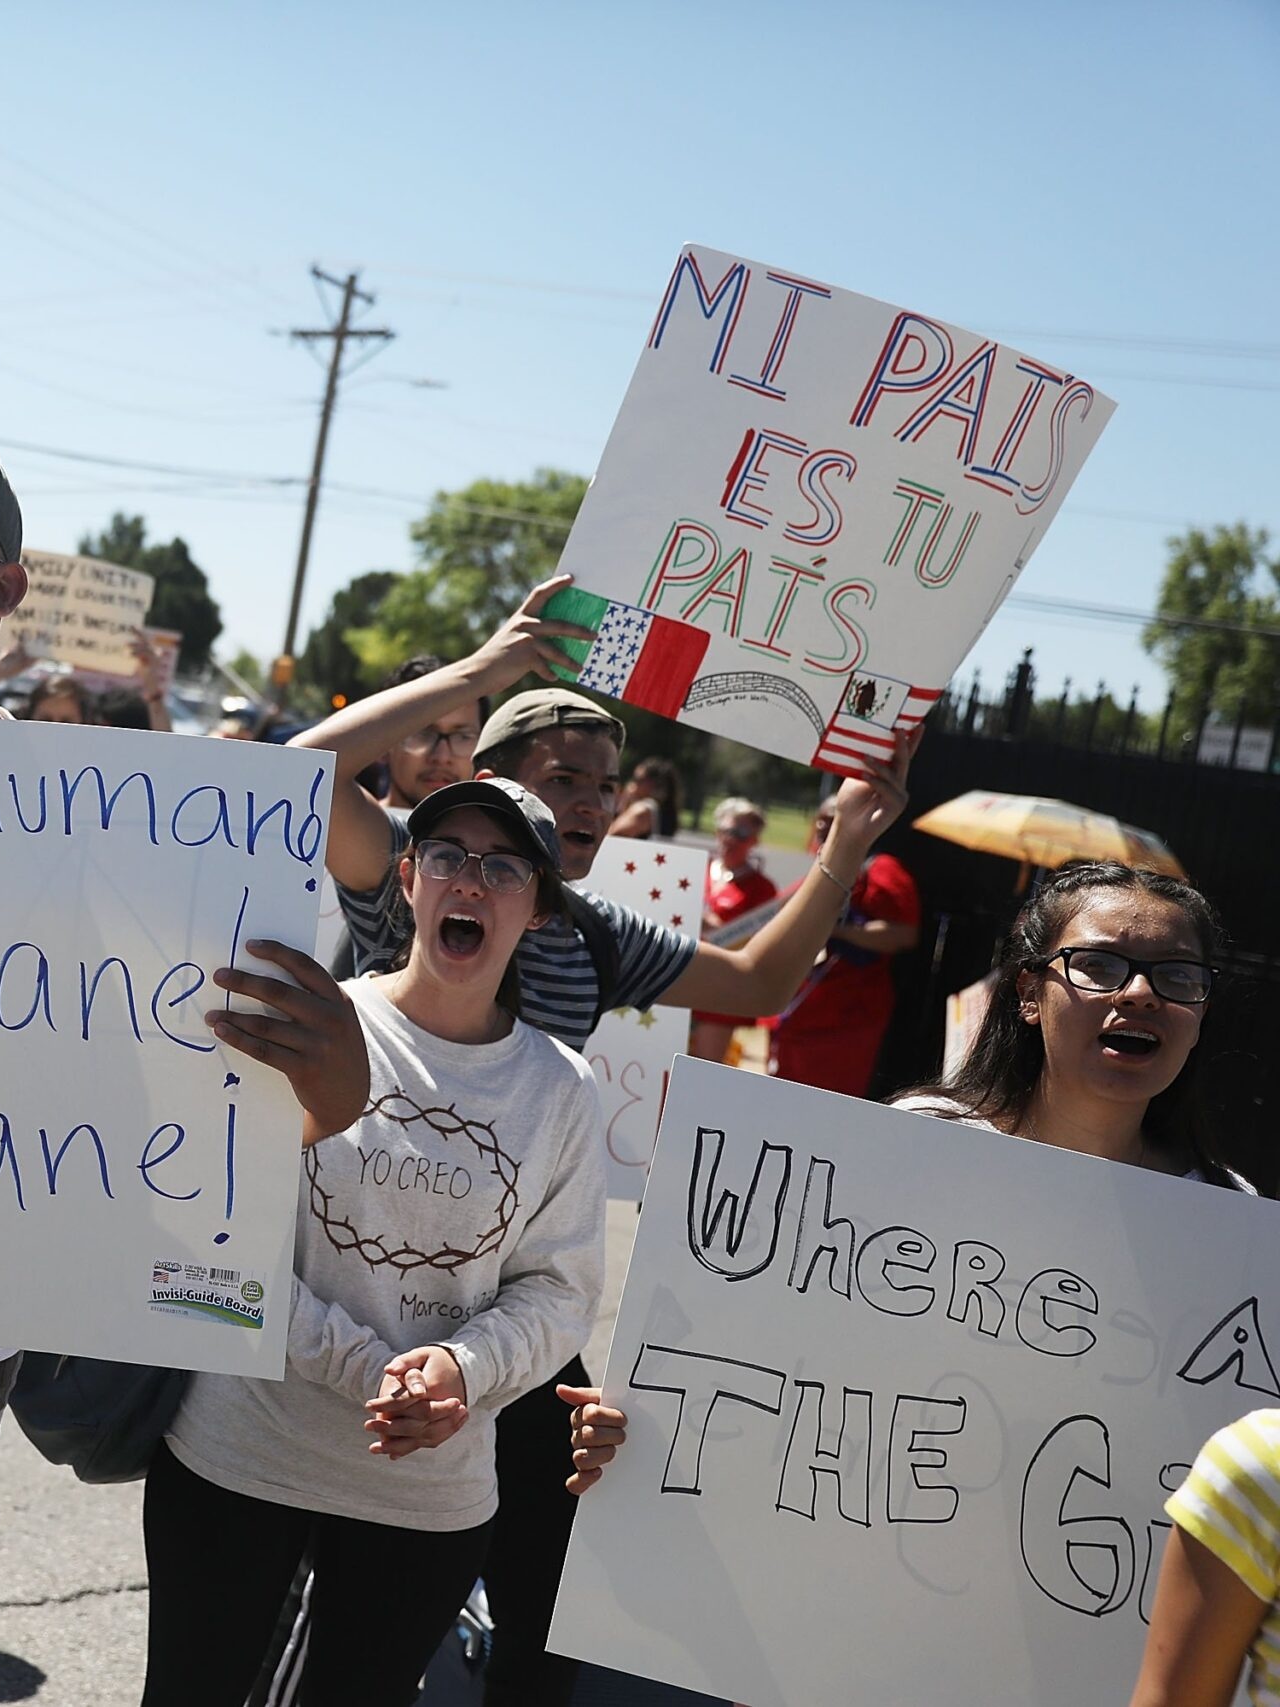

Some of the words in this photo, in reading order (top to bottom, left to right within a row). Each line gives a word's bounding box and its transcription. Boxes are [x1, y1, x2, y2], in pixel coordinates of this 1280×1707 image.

[649, 252, 831, 401] MI
[721, 428, 857, 546] ES
[883, 478, 981, 589] TU
[637, 518, 877, 677] PAÍS
[357, 1146, 392, 1185] YO
[397, 1156, 472, 1199] CREO
[152, 1288, 221, 1305] Invisi-Guide
[224, 1297, 261, 1319] Board
[399, 1293, 472, 1324] Marcos
[629, 1343, 967, 1527] THE
